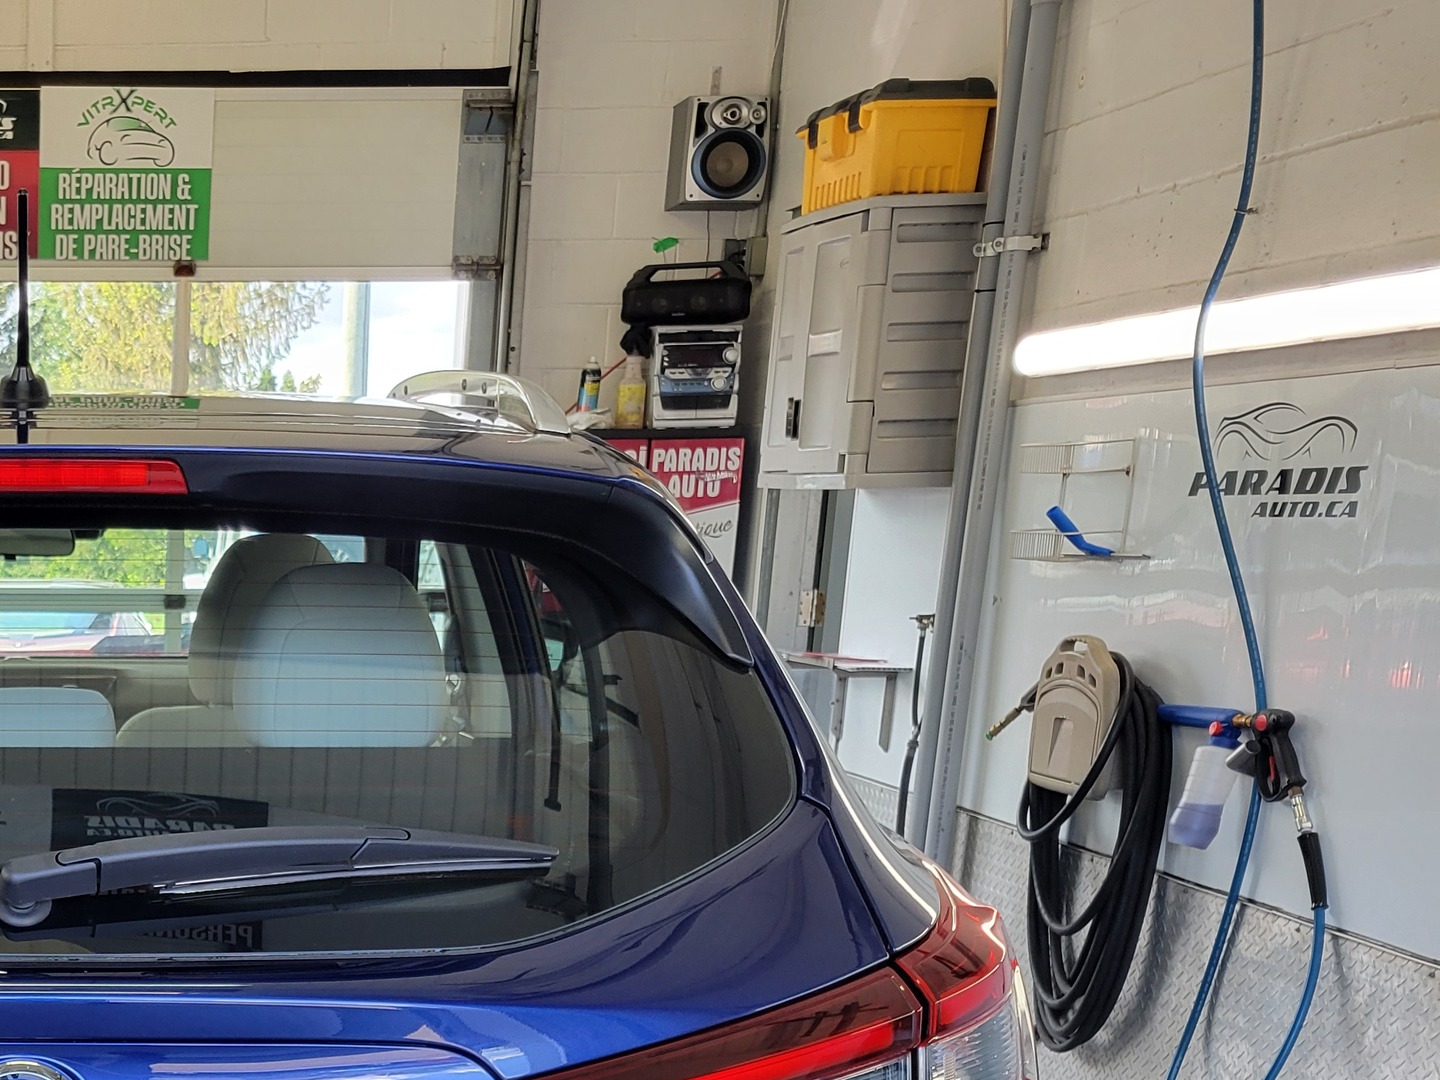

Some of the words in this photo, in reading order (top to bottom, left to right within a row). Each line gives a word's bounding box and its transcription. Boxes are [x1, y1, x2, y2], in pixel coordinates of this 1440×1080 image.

[77, 88, 177, 129] VITRXPERT
[58, 168, 172, 200] RÉPARATION
[176, 173, 192, 200] &
[50, 203, 199, 231] REMPLACEMENT
[55, 234, 79, 260] DE
[83, 234, 193, 261] PARE-BRISE
[652, 446, 741, 473] PARADIS
[667, 473, 721, 498] AUTO
[1188, 466, 1370, 497] PARADIS
[1251, 501, 1358, 518] AUTO.CA
